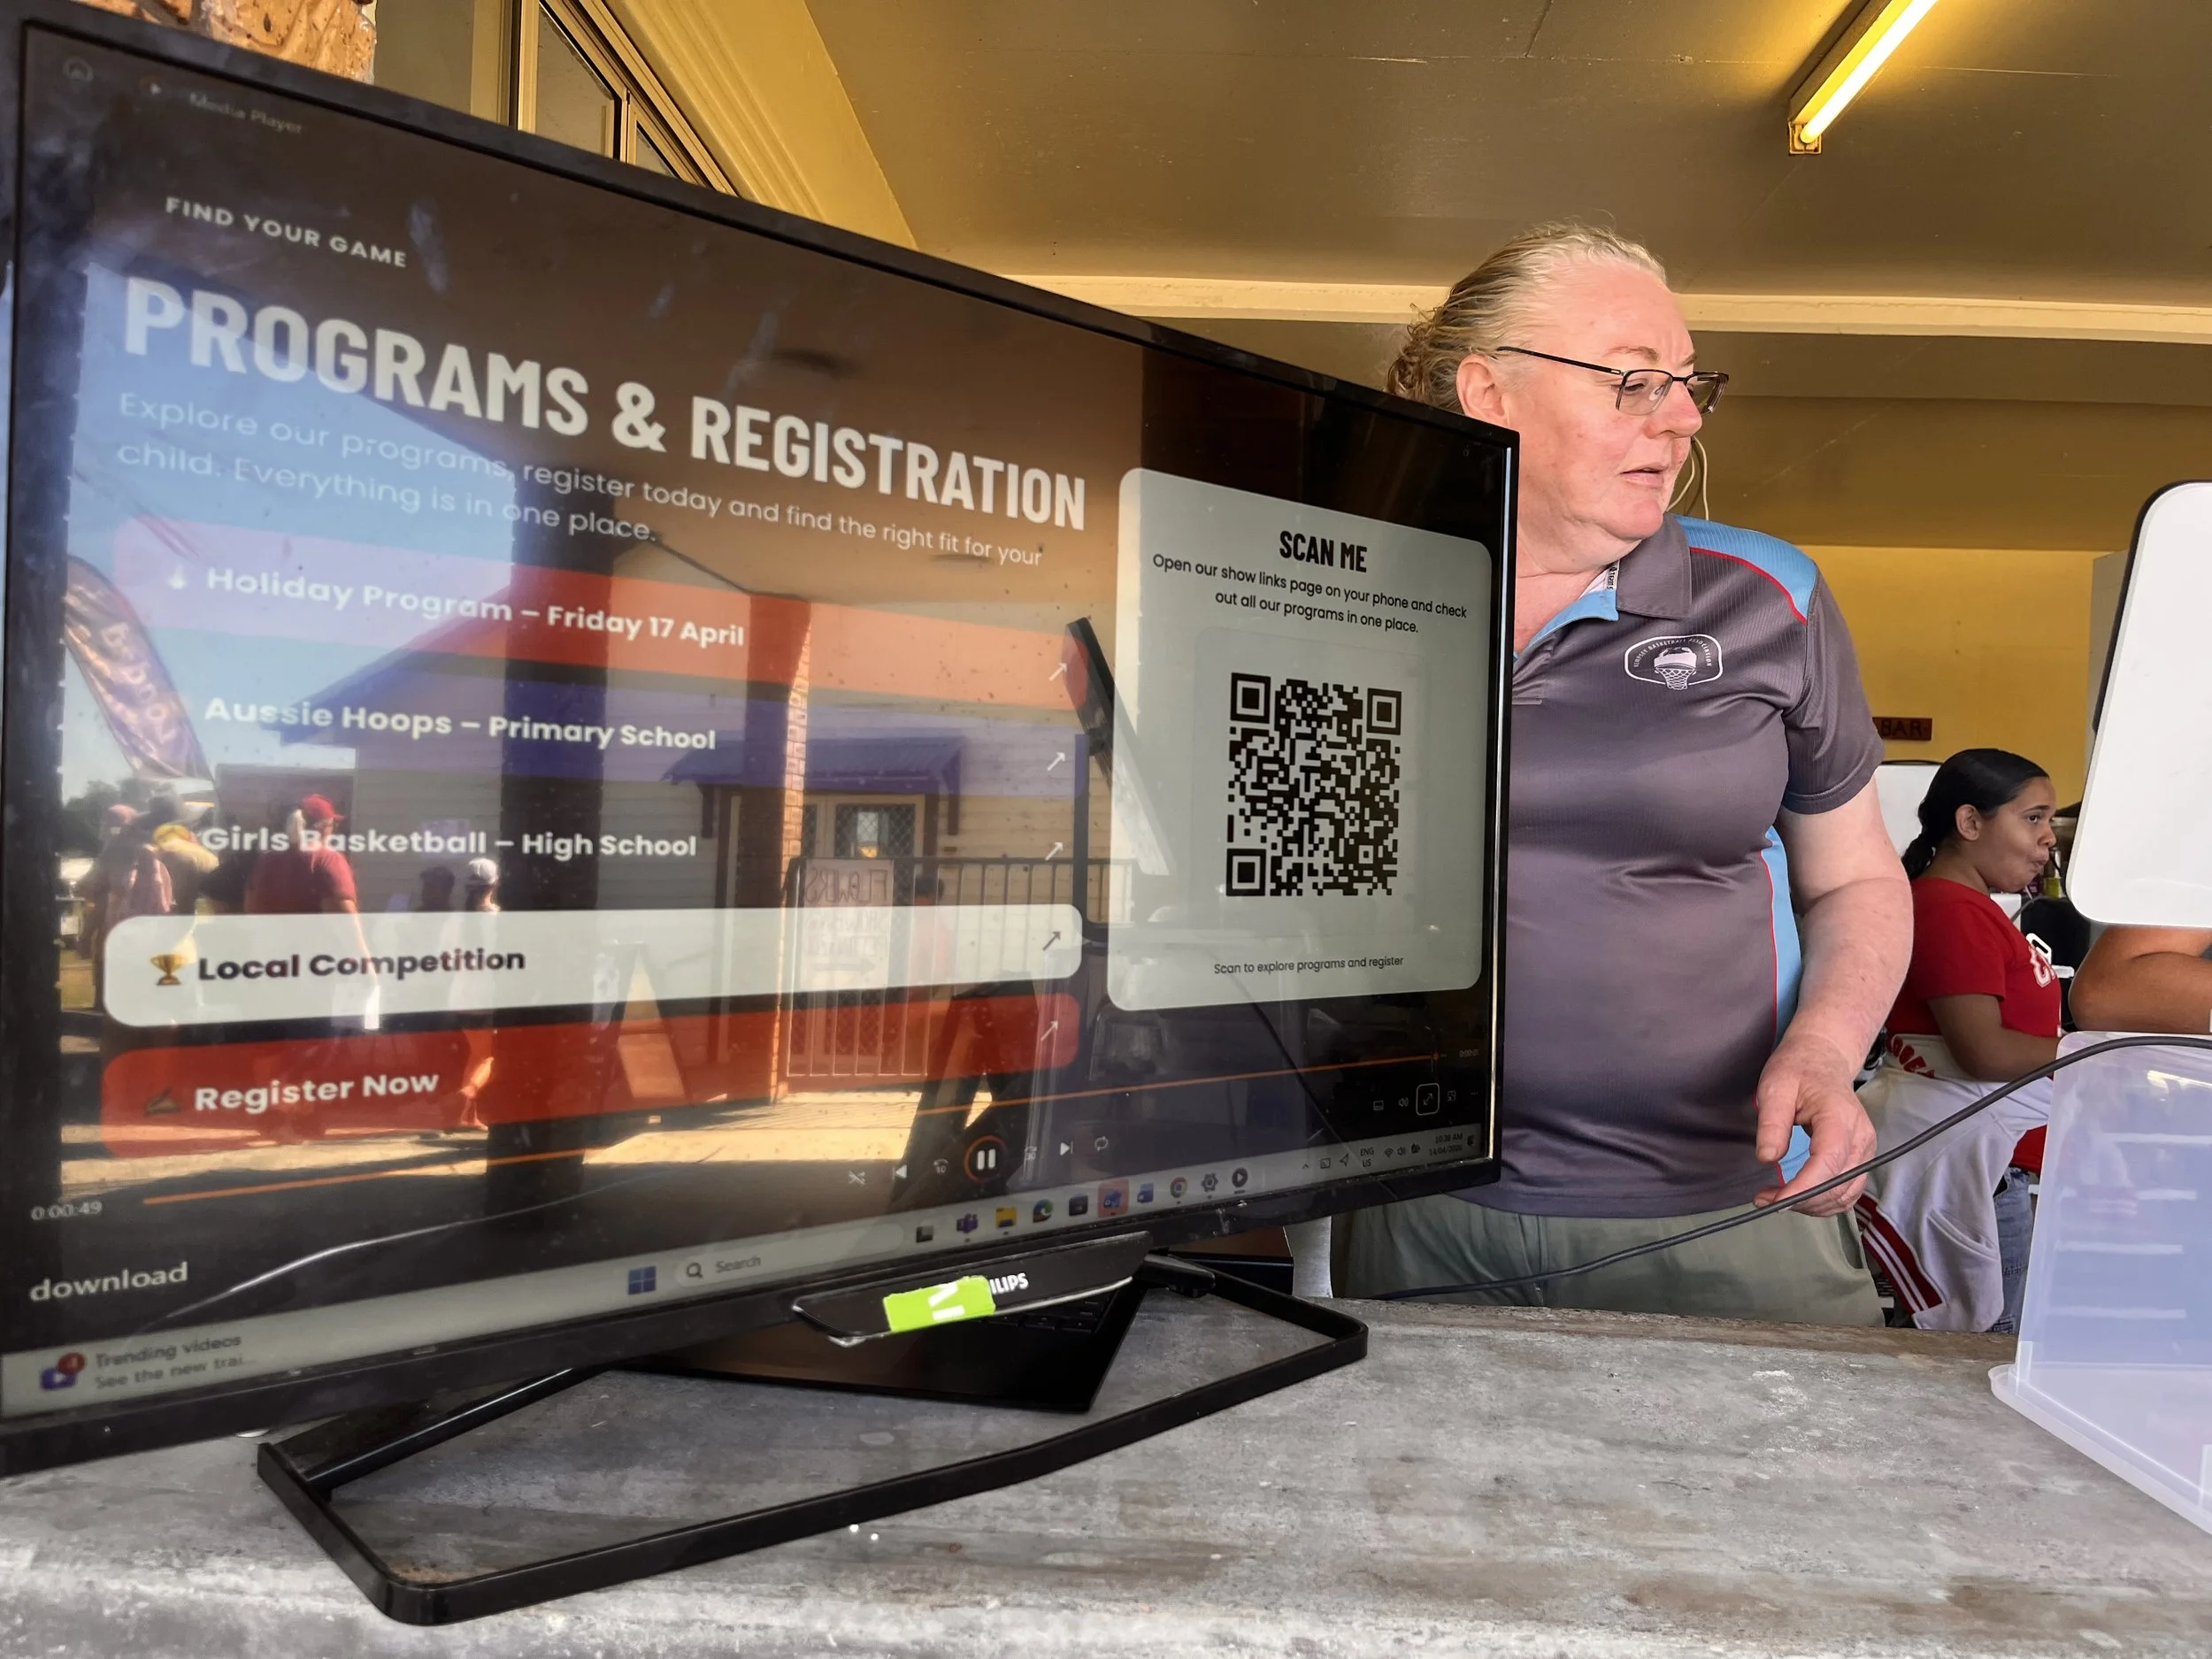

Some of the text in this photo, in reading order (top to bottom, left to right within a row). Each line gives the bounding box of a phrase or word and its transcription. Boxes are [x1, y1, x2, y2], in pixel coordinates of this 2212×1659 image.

[190, 92, 303, 134] Media Player
[165, 196, 407, 267] FIND YOUR GAME
[125, 276, 1086, 530] PROGRAMS & REGISTRATION
[118, 445, 656, 543] child. Everything is in one place.
[119, 394, 1042, 568] Explore our programs, register today and find the right fit for your
[1279, 530, 1367, 572] SCAN ME
[1153, 554, 1467, 618] Open our show links page on your phone and check
[207, 566, 355, 611] Holiday
[363, 585, 513, 621] Program
[547, 604, 643, 641] Friday
[649, 615, 675, 639] 17
[680, 619, 744, 649] April
[1215, 591, 1419, 634] out all our programs in one place.
[1687, 637, 1713, 667] ASSOCIATION
[204, 697, 333, 728] Aussie
[342, 706, 452, 741] Hoops
[489, 716, 615, 749] Primary
[620, 725, 716, 749] School
[1881, 719, 1922, 737] BAR
[202, 827, 290, 853] Girls
[299, 829, 487, 855] Basketball
[522, 833, 593, 862] High
[600, 834, 696, 856] School
[198, 948, 526, 980] Local Competition
[1214, 955, 1403, 975] Scan to explore programs and register
[195, 1072, 440, 1114] Register Now
[1363, 1158, 1371, 1167] US
[30, 1199, 103, 1221] 0:00:49
[30, 1262, 188, 1302] download
[715, 1253, 762, 1274] Search
[989, 1272, 1029, 1295] ILIPS
[96, 1334, 242, 1369] Trending videos
[95, 1374, 128, 1389] See
[134, 1368, 164, 1383] the
[170, 1362, 208, 1377] new
